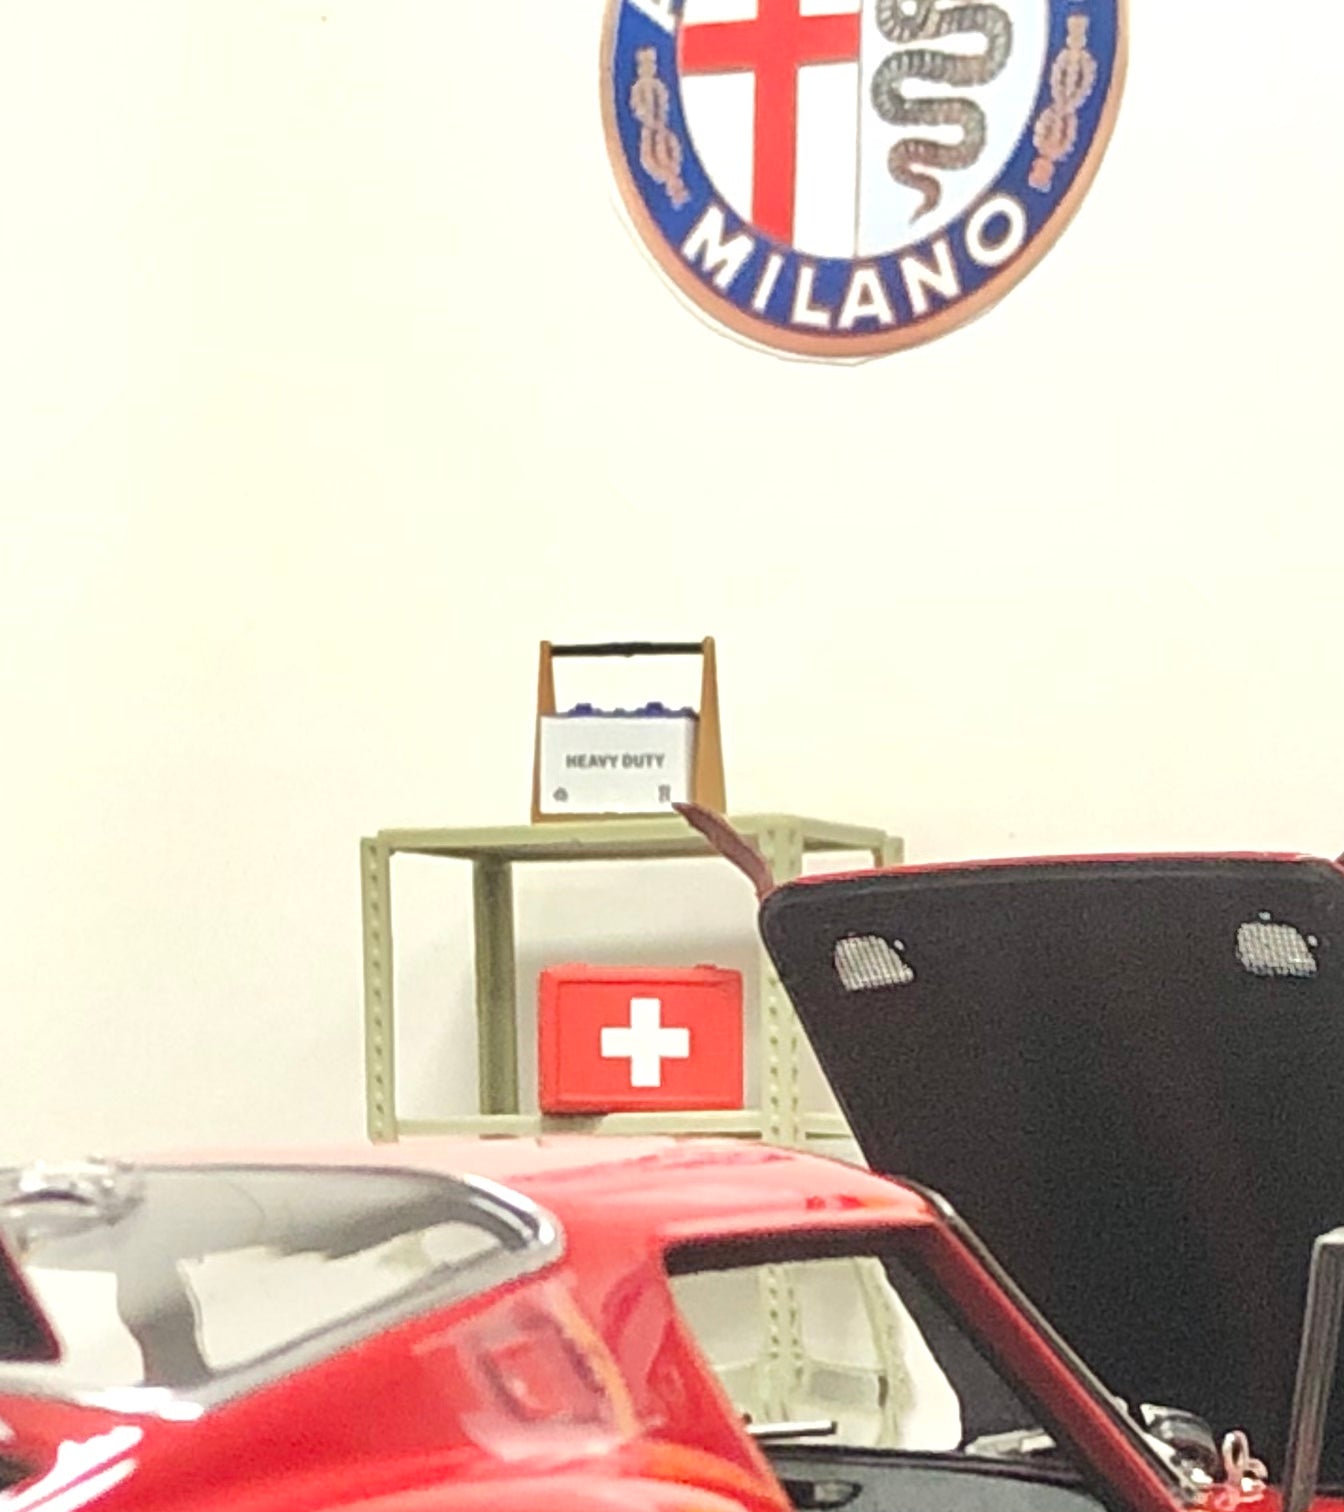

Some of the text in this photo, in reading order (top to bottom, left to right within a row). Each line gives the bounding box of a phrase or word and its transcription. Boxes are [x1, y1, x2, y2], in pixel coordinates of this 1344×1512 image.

[682, 191, 1026, 329] MILANO
[565, 752, 665, 769] HEAVY DUTY
